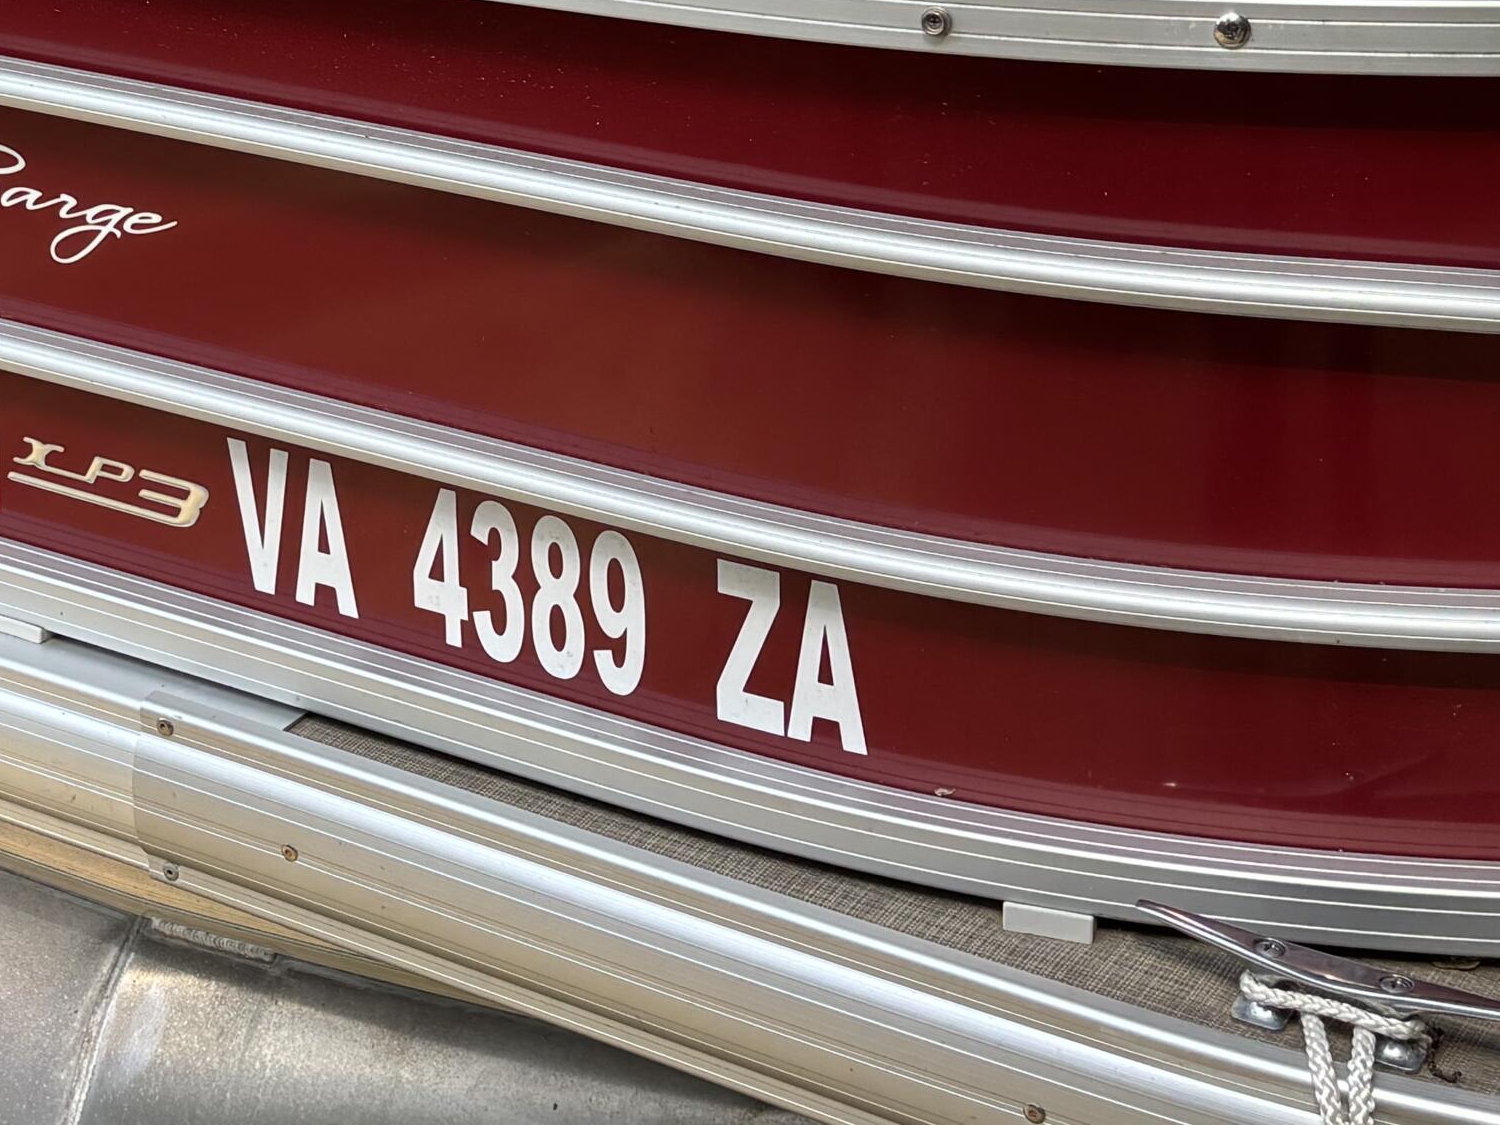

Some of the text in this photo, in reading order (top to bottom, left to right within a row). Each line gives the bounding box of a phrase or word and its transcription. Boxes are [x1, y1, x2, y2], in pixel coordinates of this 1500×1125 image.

[226, 437, 868, 756] VA 4389 ZA
